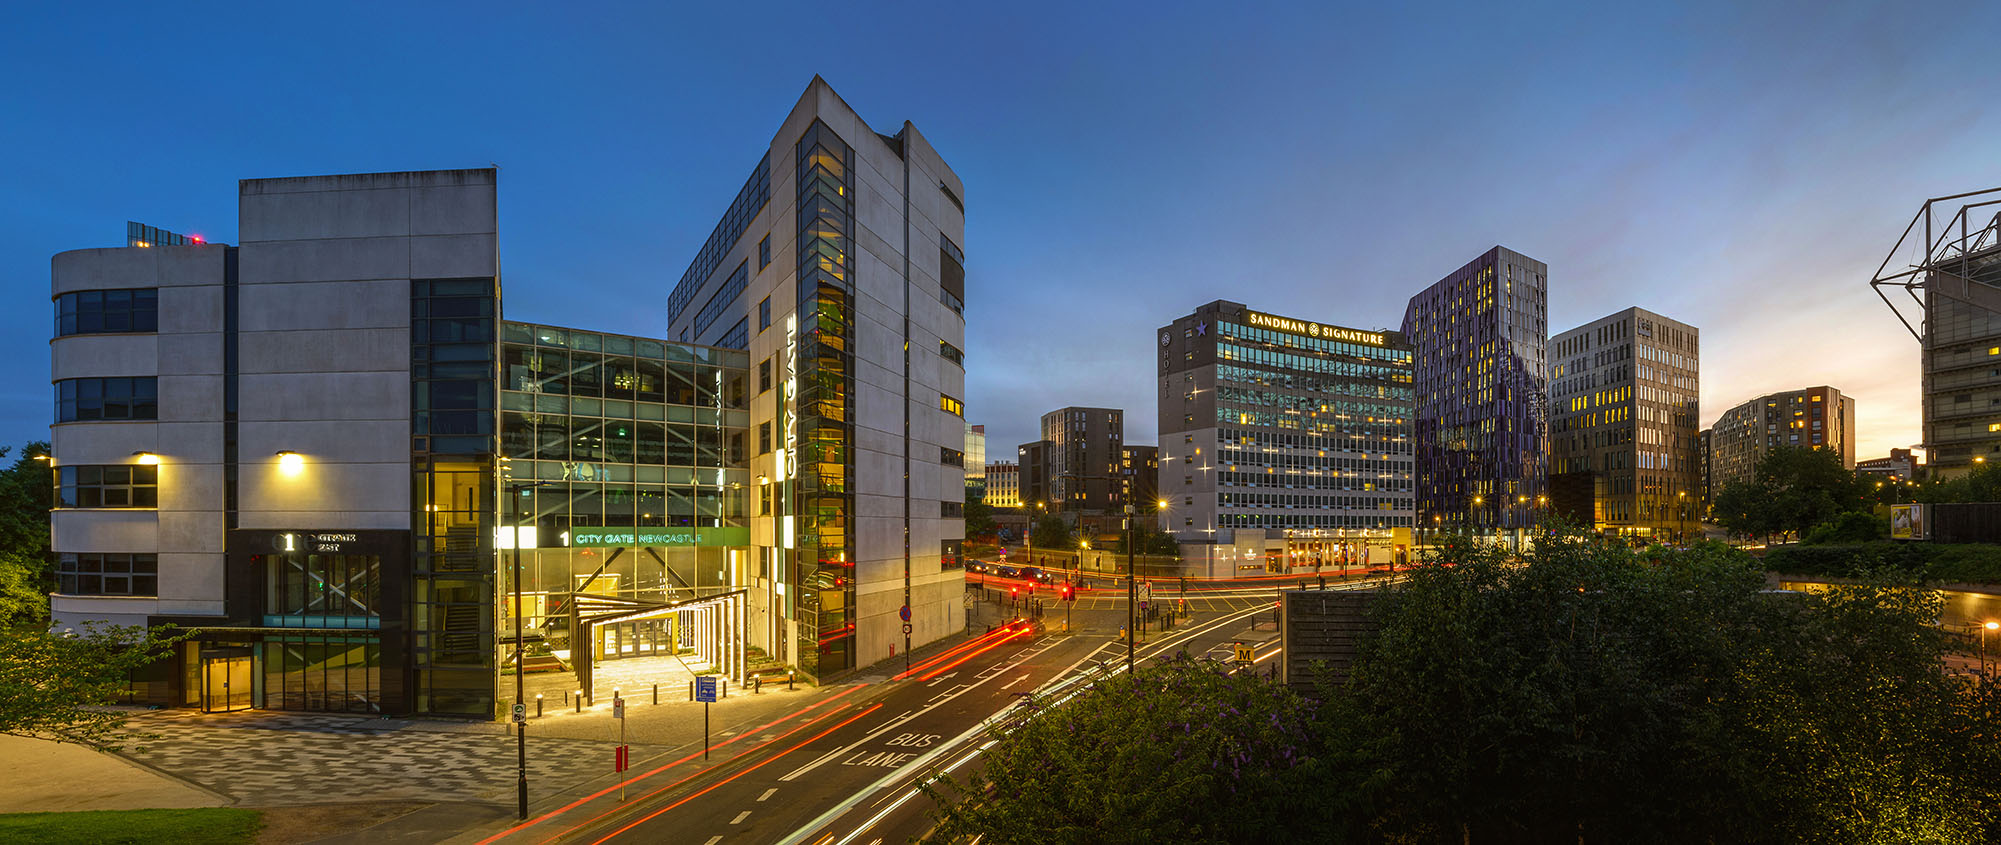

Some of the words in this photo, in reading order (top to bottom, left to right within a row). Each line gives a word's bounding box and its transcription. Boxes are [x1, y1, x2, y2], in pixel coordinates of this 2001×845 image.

[1250, 313, 1306, 333] SANDMAN
[1322, 326, 1384, 345] SIGNATURE
[787, 312, 796, 401] GATE
[787, 408, 796, 479] CITY
[560, 531, 569, 547] 1
[575, 534, 603, 544] CITY
[604, 534, 635, 544] GATE
[638, 534, 702, 544] NEWCASTLE
[1239, 650, 1250, 660] M
[885, 732, 941, 748] BUS
[841, 750, 918, 768] LANE
